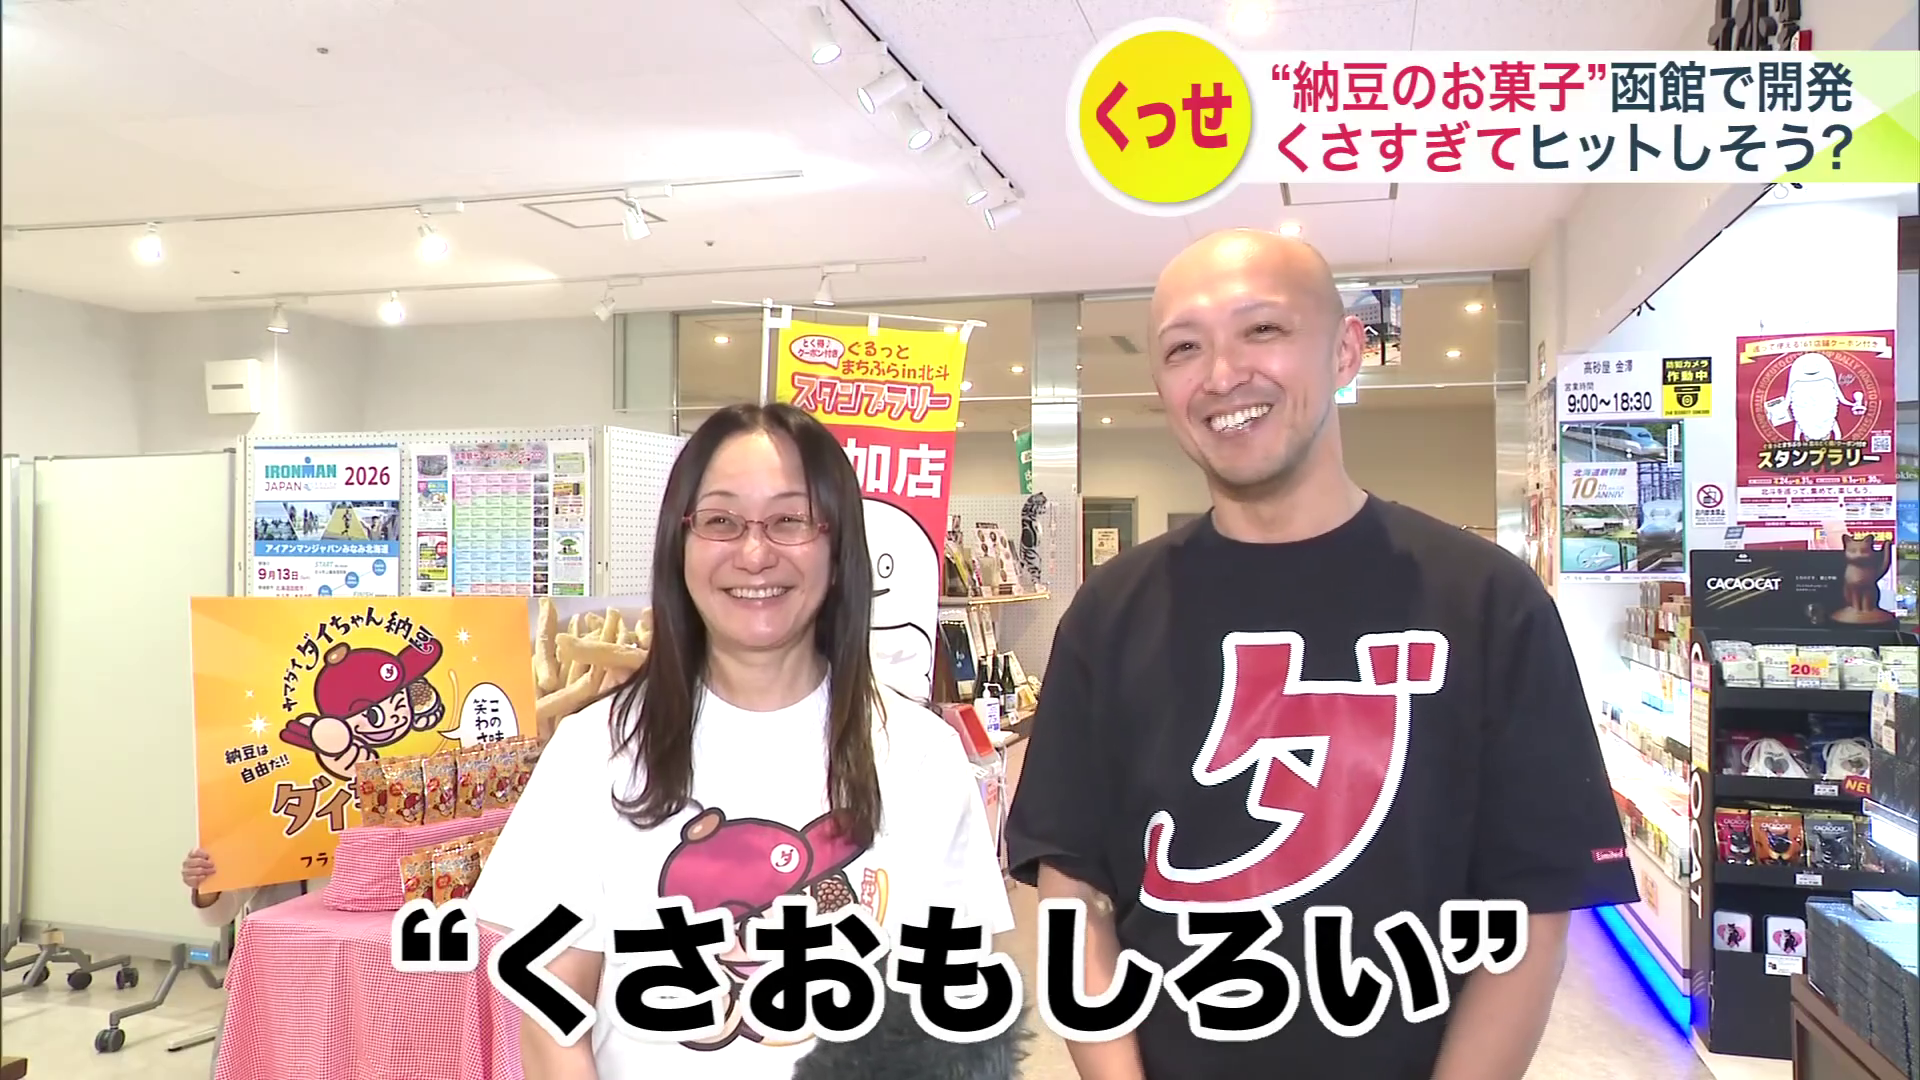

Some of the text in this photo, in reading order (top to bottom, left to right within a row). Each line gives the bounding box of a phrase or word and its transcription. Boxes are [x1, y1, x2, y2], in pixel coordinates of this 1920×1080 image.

[797, 349, 839, 359] クーポン付き
[847, 341, 910, 360] ぐるっと
[841, 359, 950, 381] まちぶらin北斗
[1667, 370, 1708, 382] 作動中
[1564, 382, 1594, 391] 営業時間
[792, 373, 951, 422] スタンプラリー
[1757, 448, 1881, 469] スタンプラリー
[265, 462, 337, 478] IRONMAN
[344, 466, 391, 486] 2026
[1573, 468, 1628, 477] 北海道新幹線
[265, 481, 302, 492] JAPAN
[265, 544, 389, 554] アイアンマンジャパンみなみ北海道
[257, 568, 299, 581] 9月13日
[1706, 577, 1782, 590] CACAOCAT
[296, 606, 434, 670] ダイちゃん納豆
[1790, 664, 1821, 676] 20%
[224, 744, 269, 765] 納豆は
[240, 753, 290, 784] 自由だ!!
[1139, 630, 1450, 914] ダ
